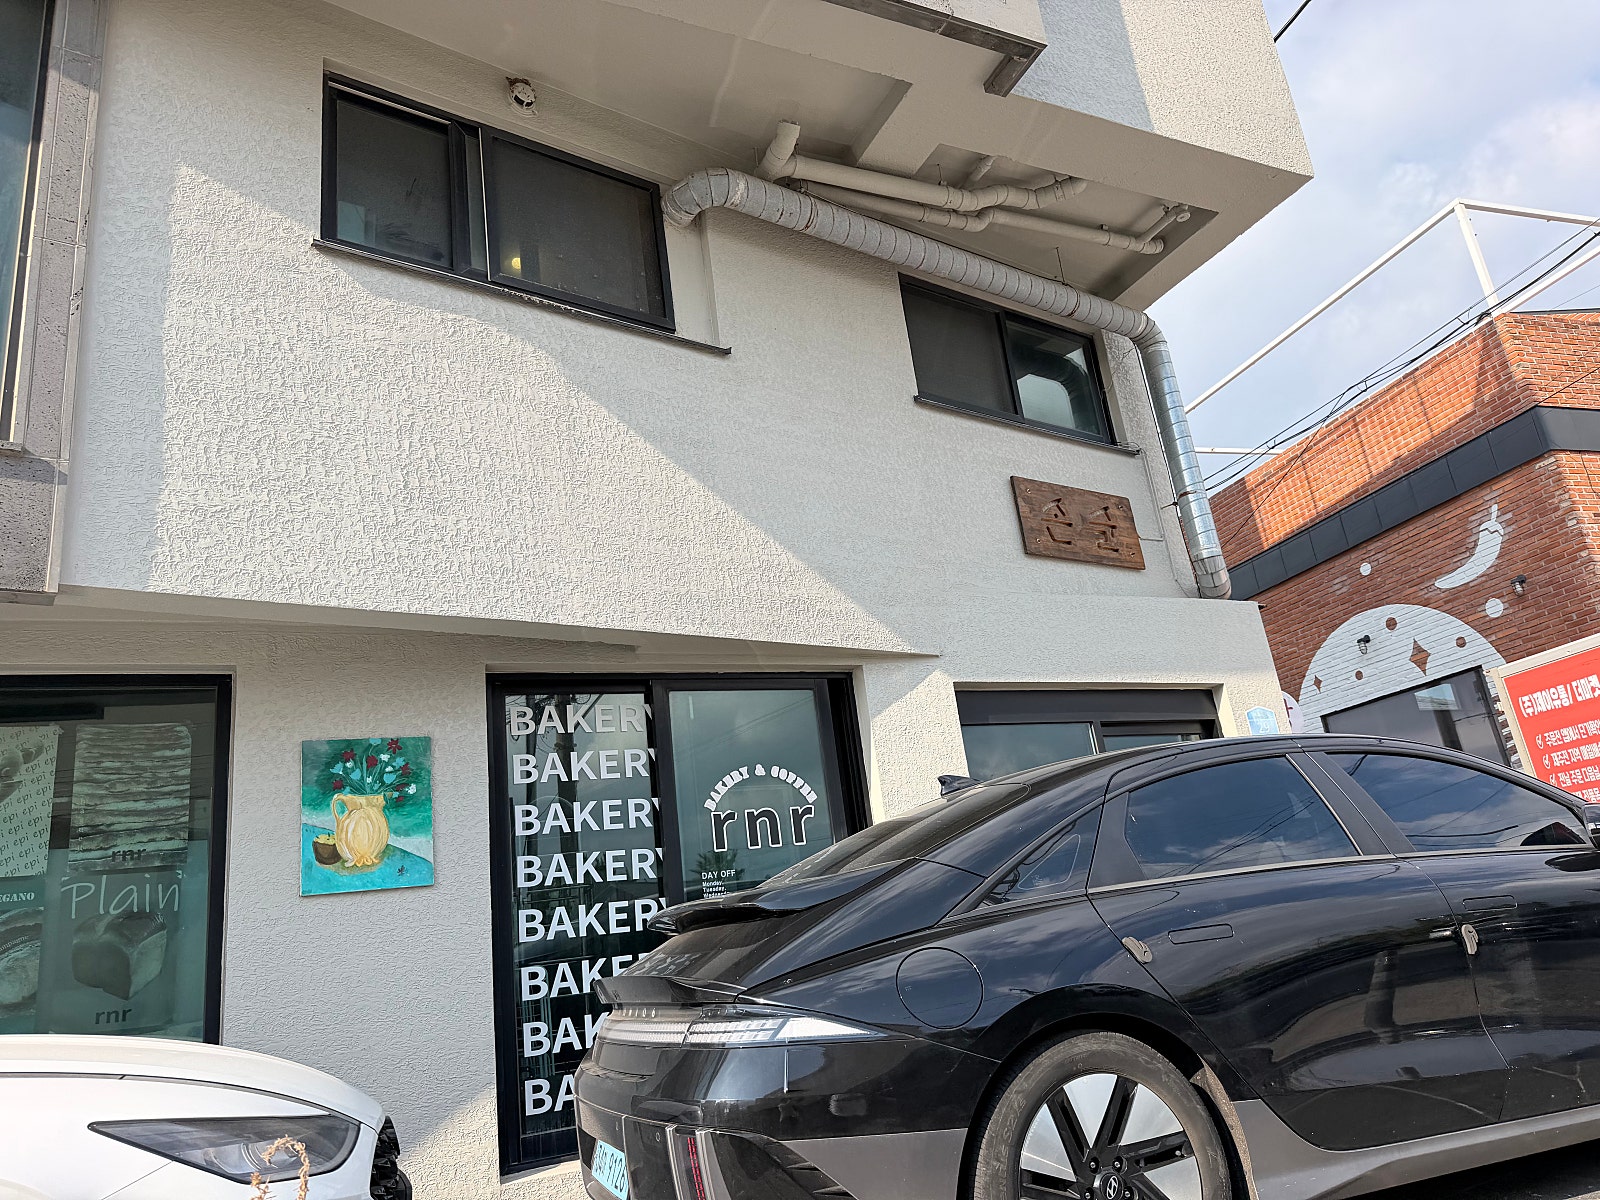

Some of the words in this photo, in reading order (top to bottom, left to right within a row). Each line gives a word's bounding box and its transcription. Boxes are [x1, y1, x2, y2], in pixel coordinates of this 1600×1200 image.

[45, 741, 54, 755] pi
[45, 756, 56, 766] ep
[754, 764, 766, 776] &
[42, 798, 53, 807] ep
[710, 804, 815, 852] rnr
[38, 840, 49, 850] ep
[701, 871, 718, 880] DAY
[720, 869, 736, 878] OFF
[60, 873, 180, 920] Plain
[519, 897, 666, 943] BAKER
[520, 953, 649, 1002] BAKE
[94, 1008, 133, 1025] rnr
